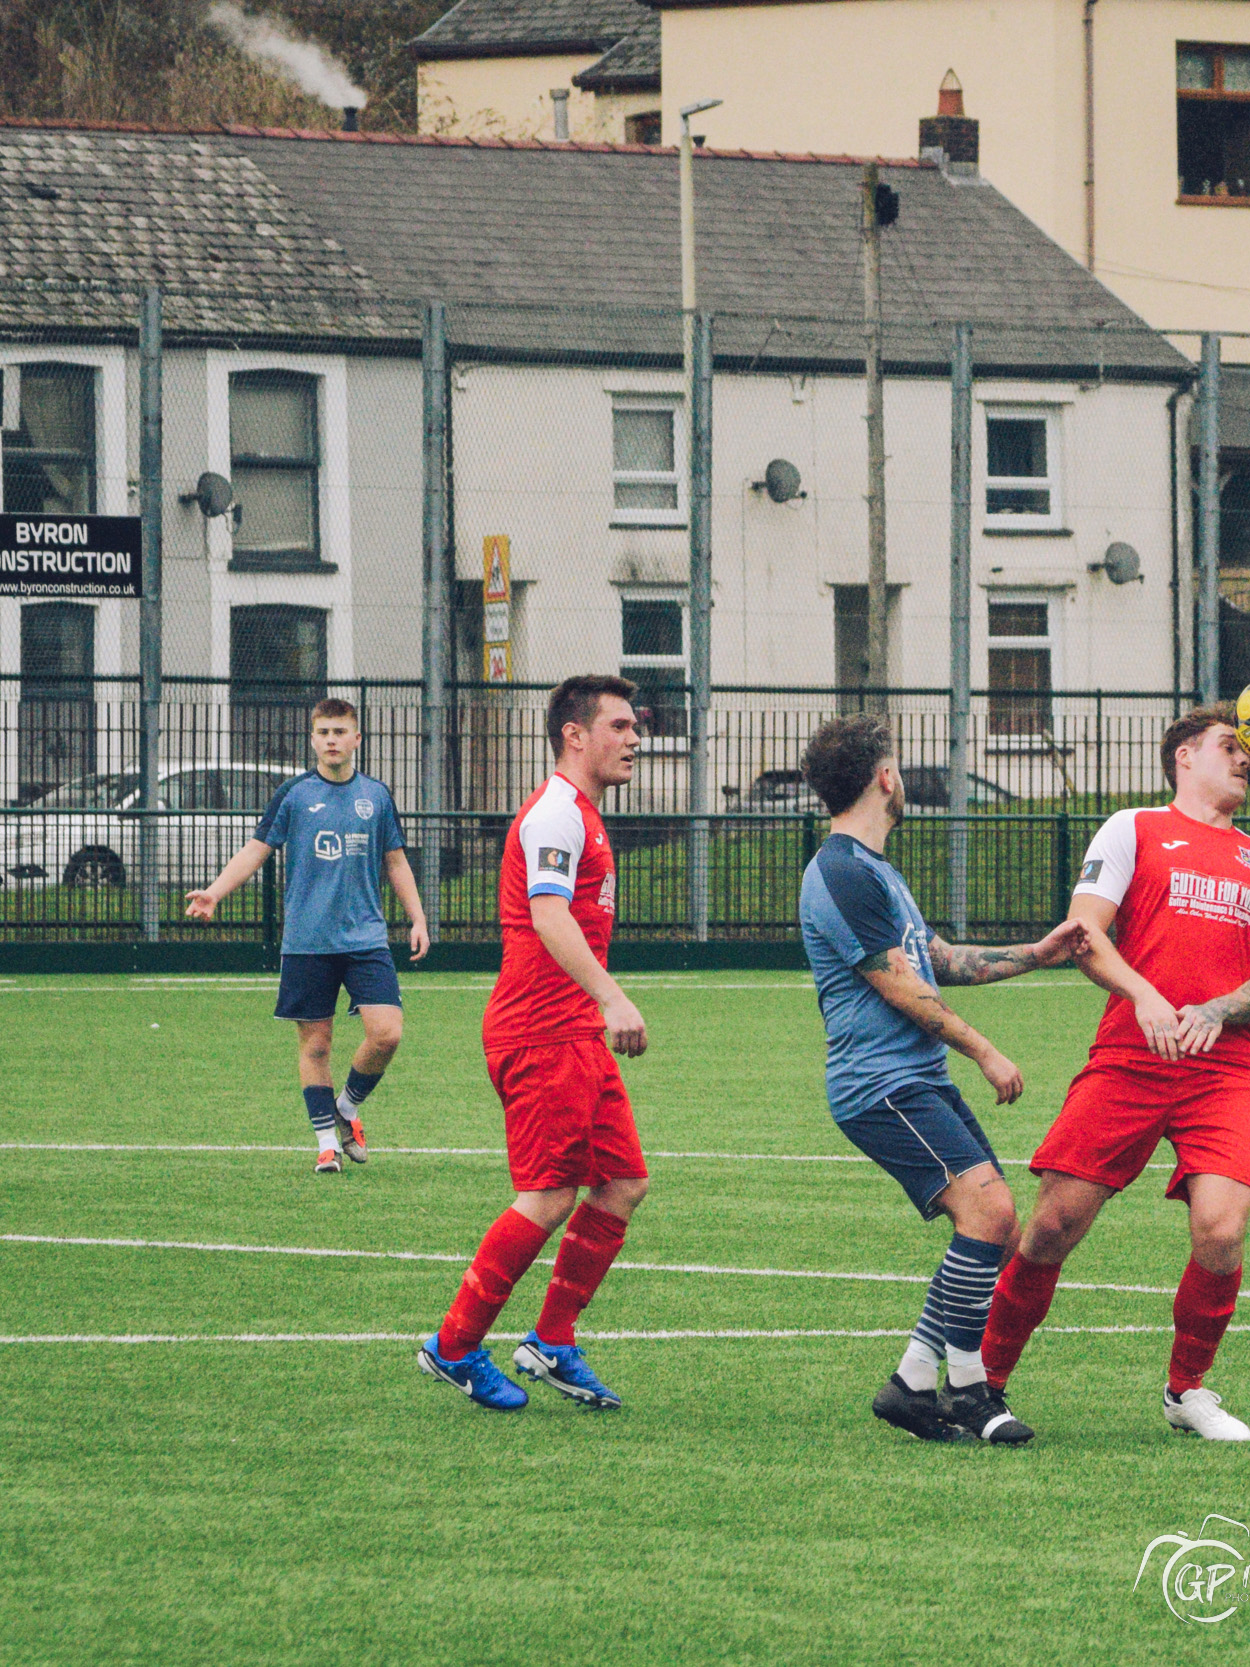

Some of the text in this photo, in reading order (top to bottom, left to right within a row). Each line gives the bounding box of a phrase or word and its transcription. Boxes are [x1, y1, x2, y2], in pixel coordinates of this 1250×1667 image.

[16, 522, 88, 545] BYRON
[0, 550, 131, 574] NSTRUCTION
[1170, 871, 1216, 900] GUTTER
[1217, 880, 1239, 904] FOR
[1168, 896, 1189, 907] Gutter
